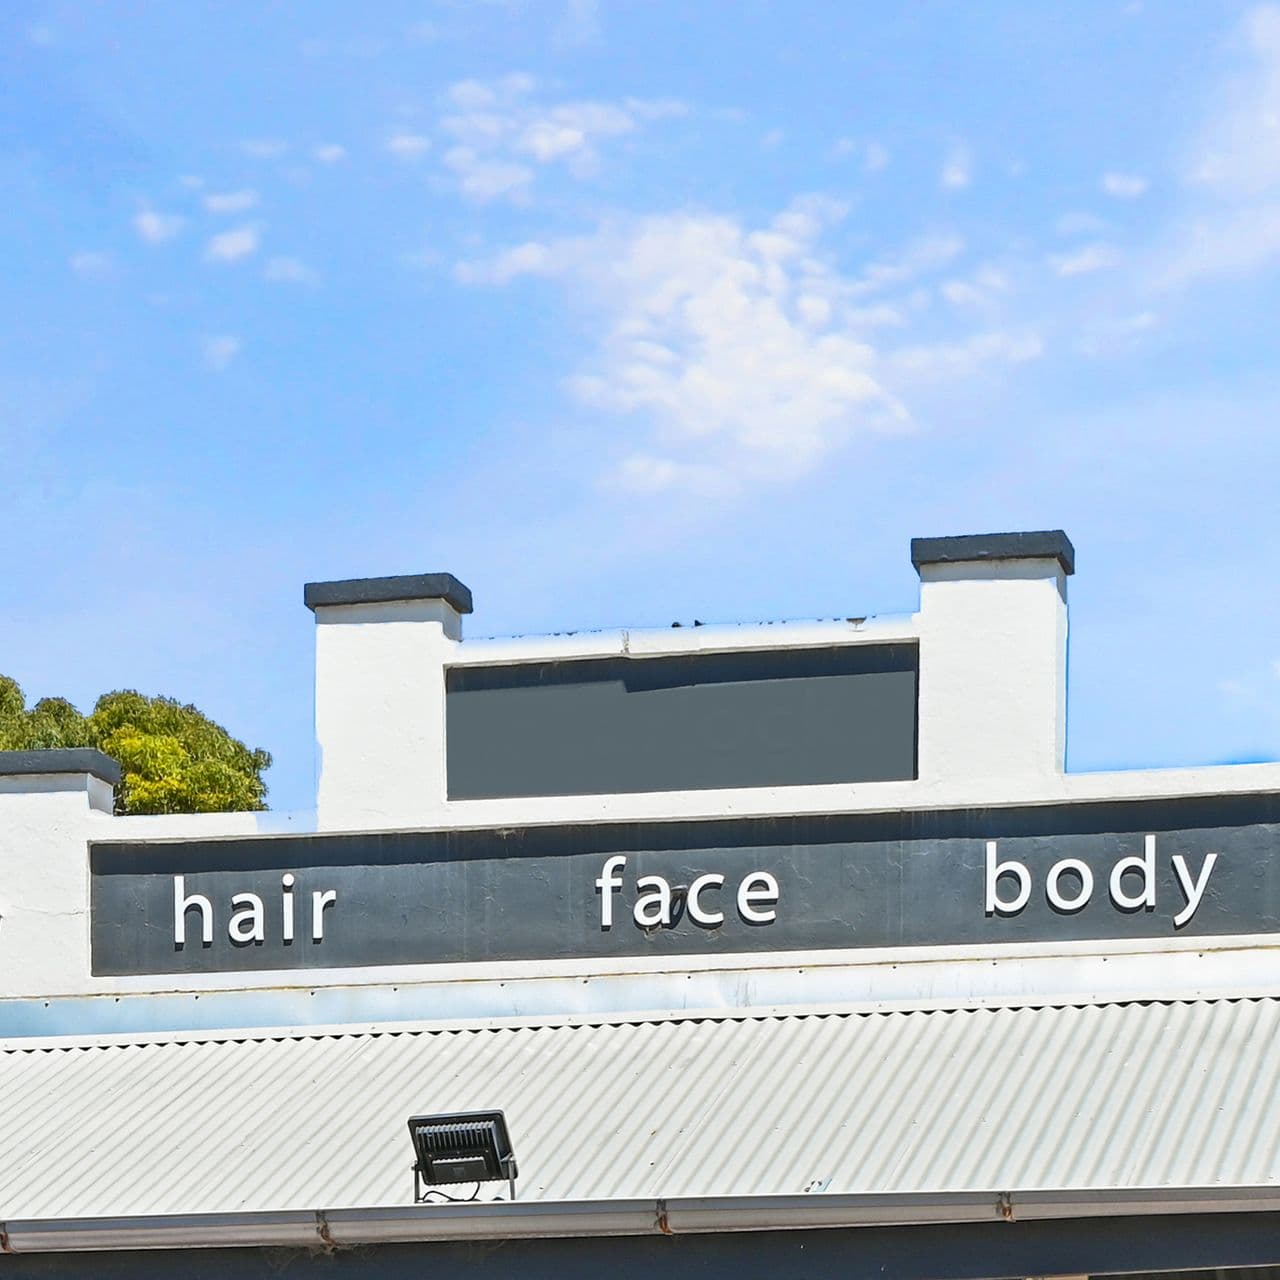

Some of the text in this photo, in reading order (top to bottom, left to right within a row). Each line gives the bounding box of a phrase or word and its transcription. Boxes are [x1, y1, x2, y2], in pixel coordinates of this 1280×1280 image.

[174, 834, 1218, 944] hair face body
